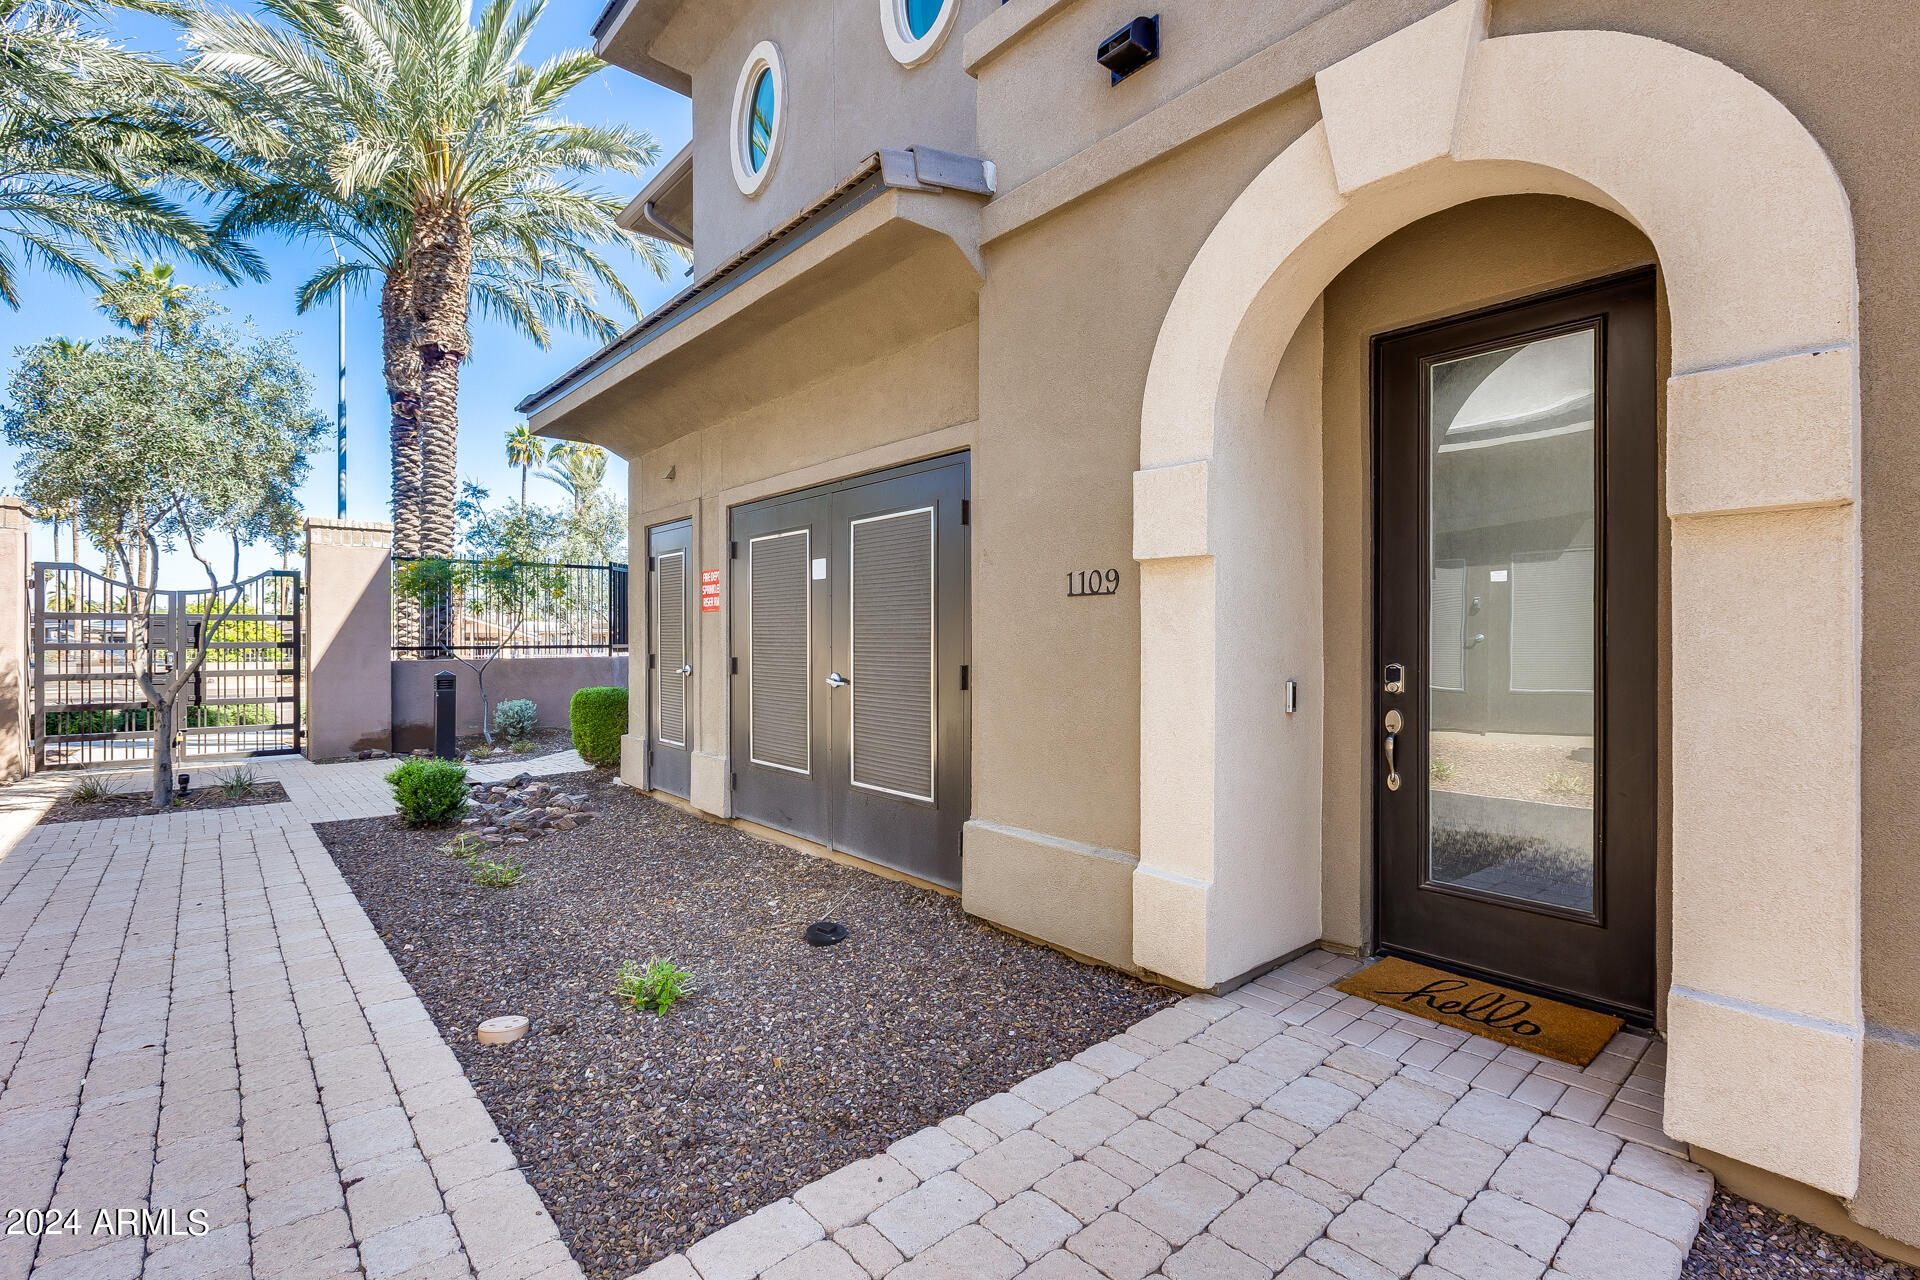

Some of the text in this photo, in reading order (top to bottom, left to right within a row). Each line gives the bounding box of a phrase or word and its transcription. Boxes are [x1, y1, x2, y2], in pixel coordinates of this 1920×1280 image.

[711, 571, 720, 581] DEP
[1067, 568, 1120, 596] 1109
[702, 584, 720, 595] SPRINKLE
[1375, 979, 1542, 1036] hello
